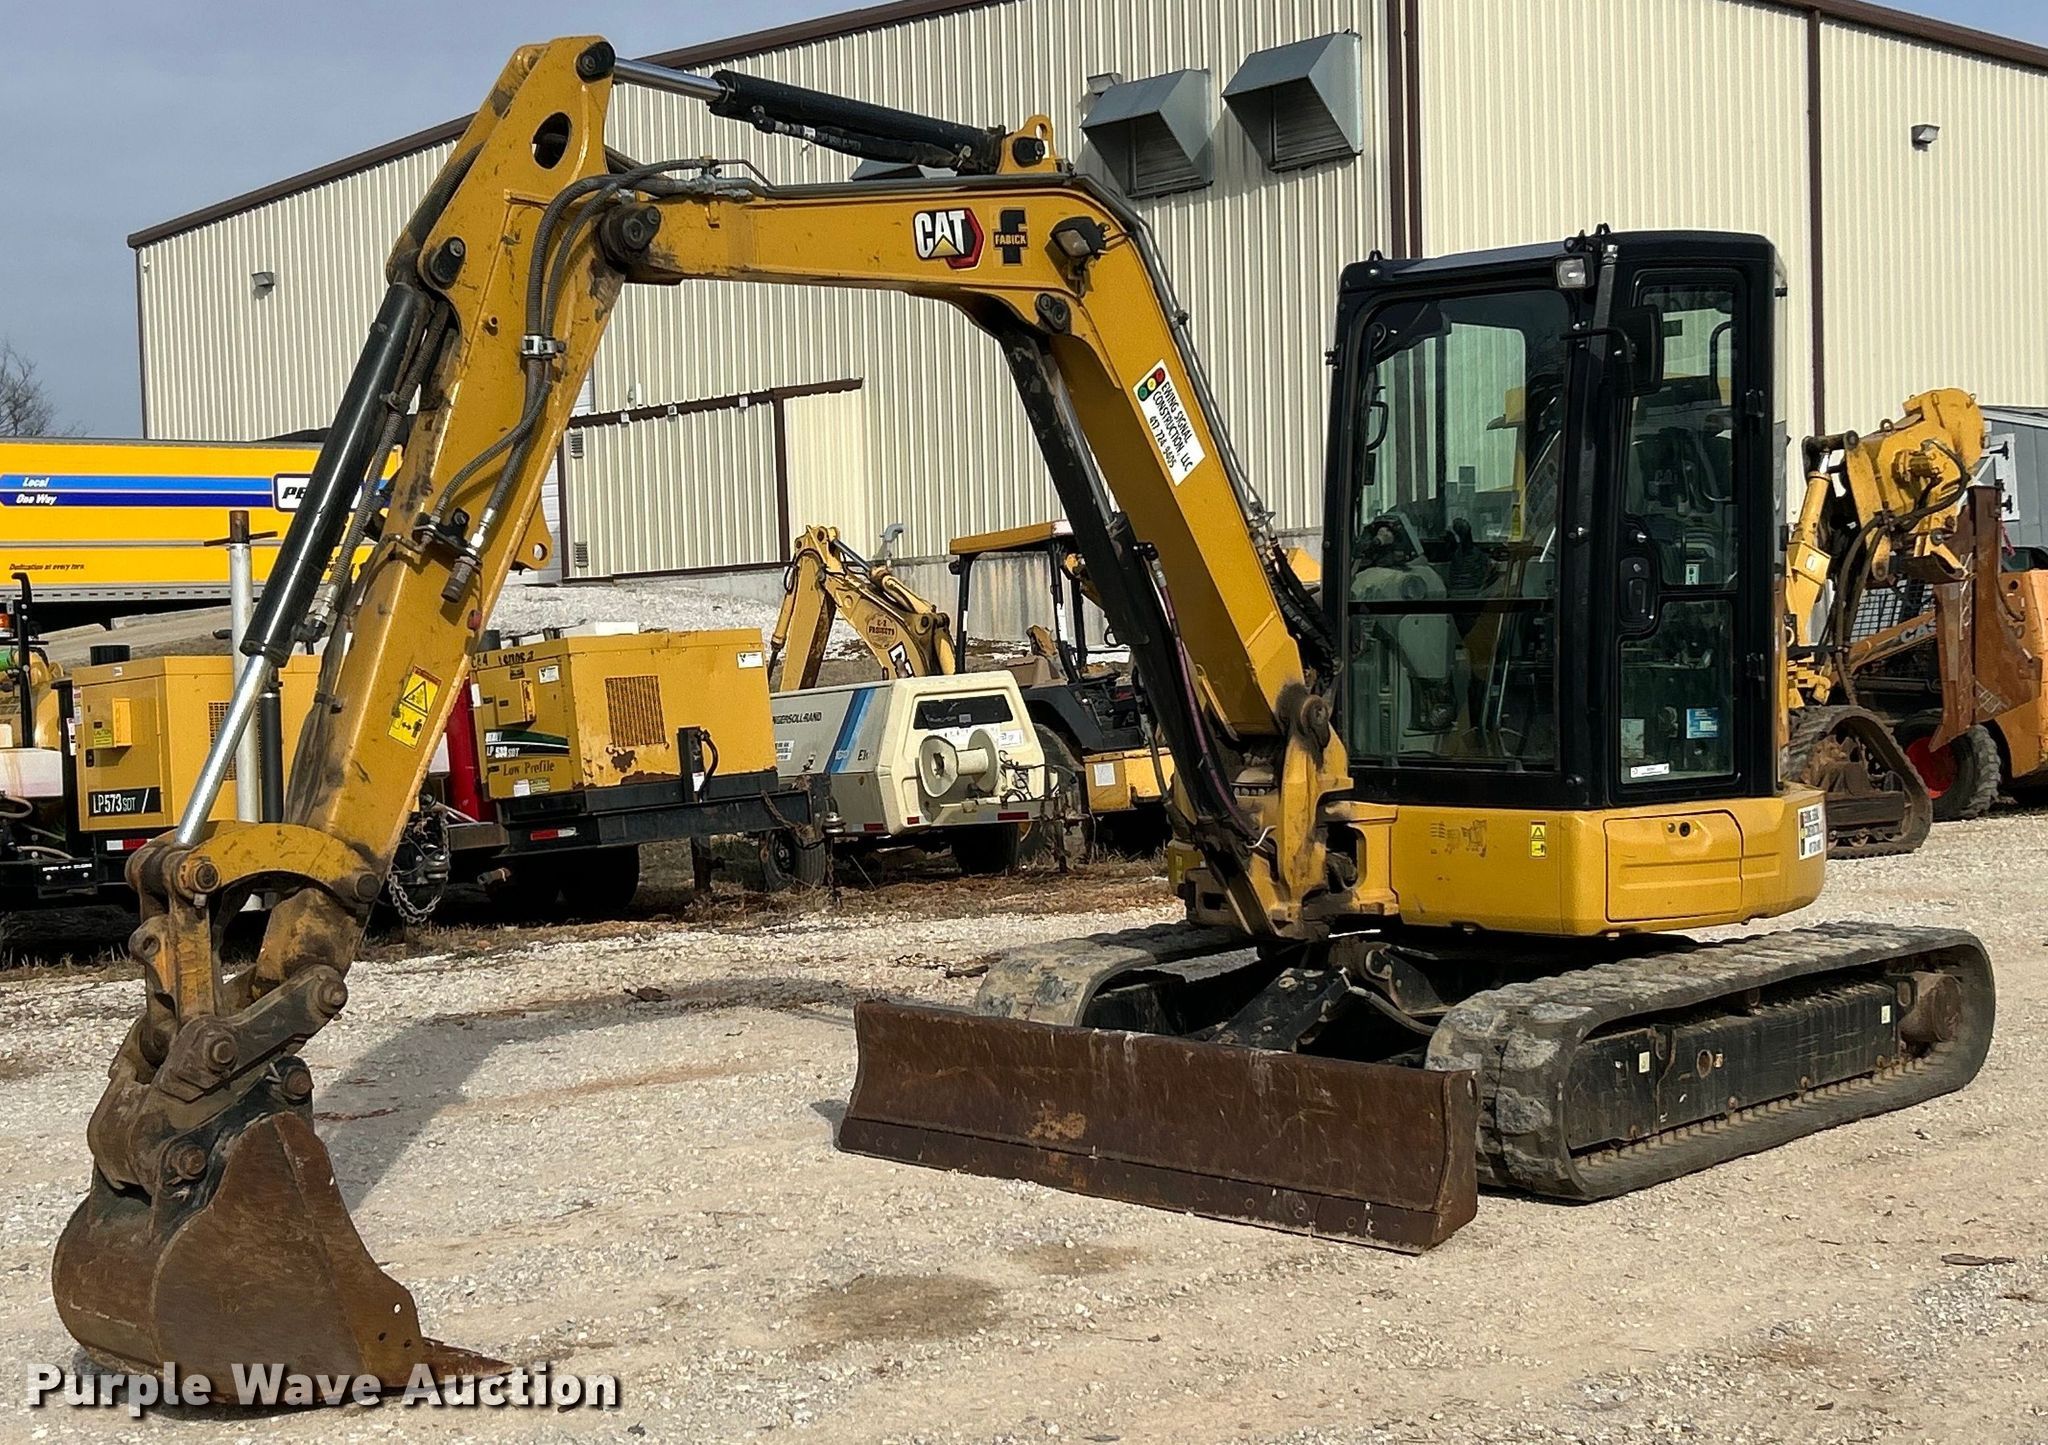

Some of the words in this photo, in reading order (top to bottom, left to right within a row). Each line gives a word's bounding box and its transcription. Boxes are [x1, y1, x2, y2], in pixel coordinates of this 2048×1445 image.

[914, 210, 965, 258] CAT
[995, 234, 1027, 245] FABICK
[1161, 381, 1180, 413] EWING
[1174, 410, 1193, 444] SIGNAL
[1149, 415, 1160, 430] 417
[1155, 429, 1165, 447] 724
[1180, 452, 1193, 472] LLC
[22, 477, 49, 488] Local
[16, 494, 35, 504] One
[36, 493, 57, 506] Way
[503, 764, 520, 776] Low
[524, 760, 555, 774] Profile
